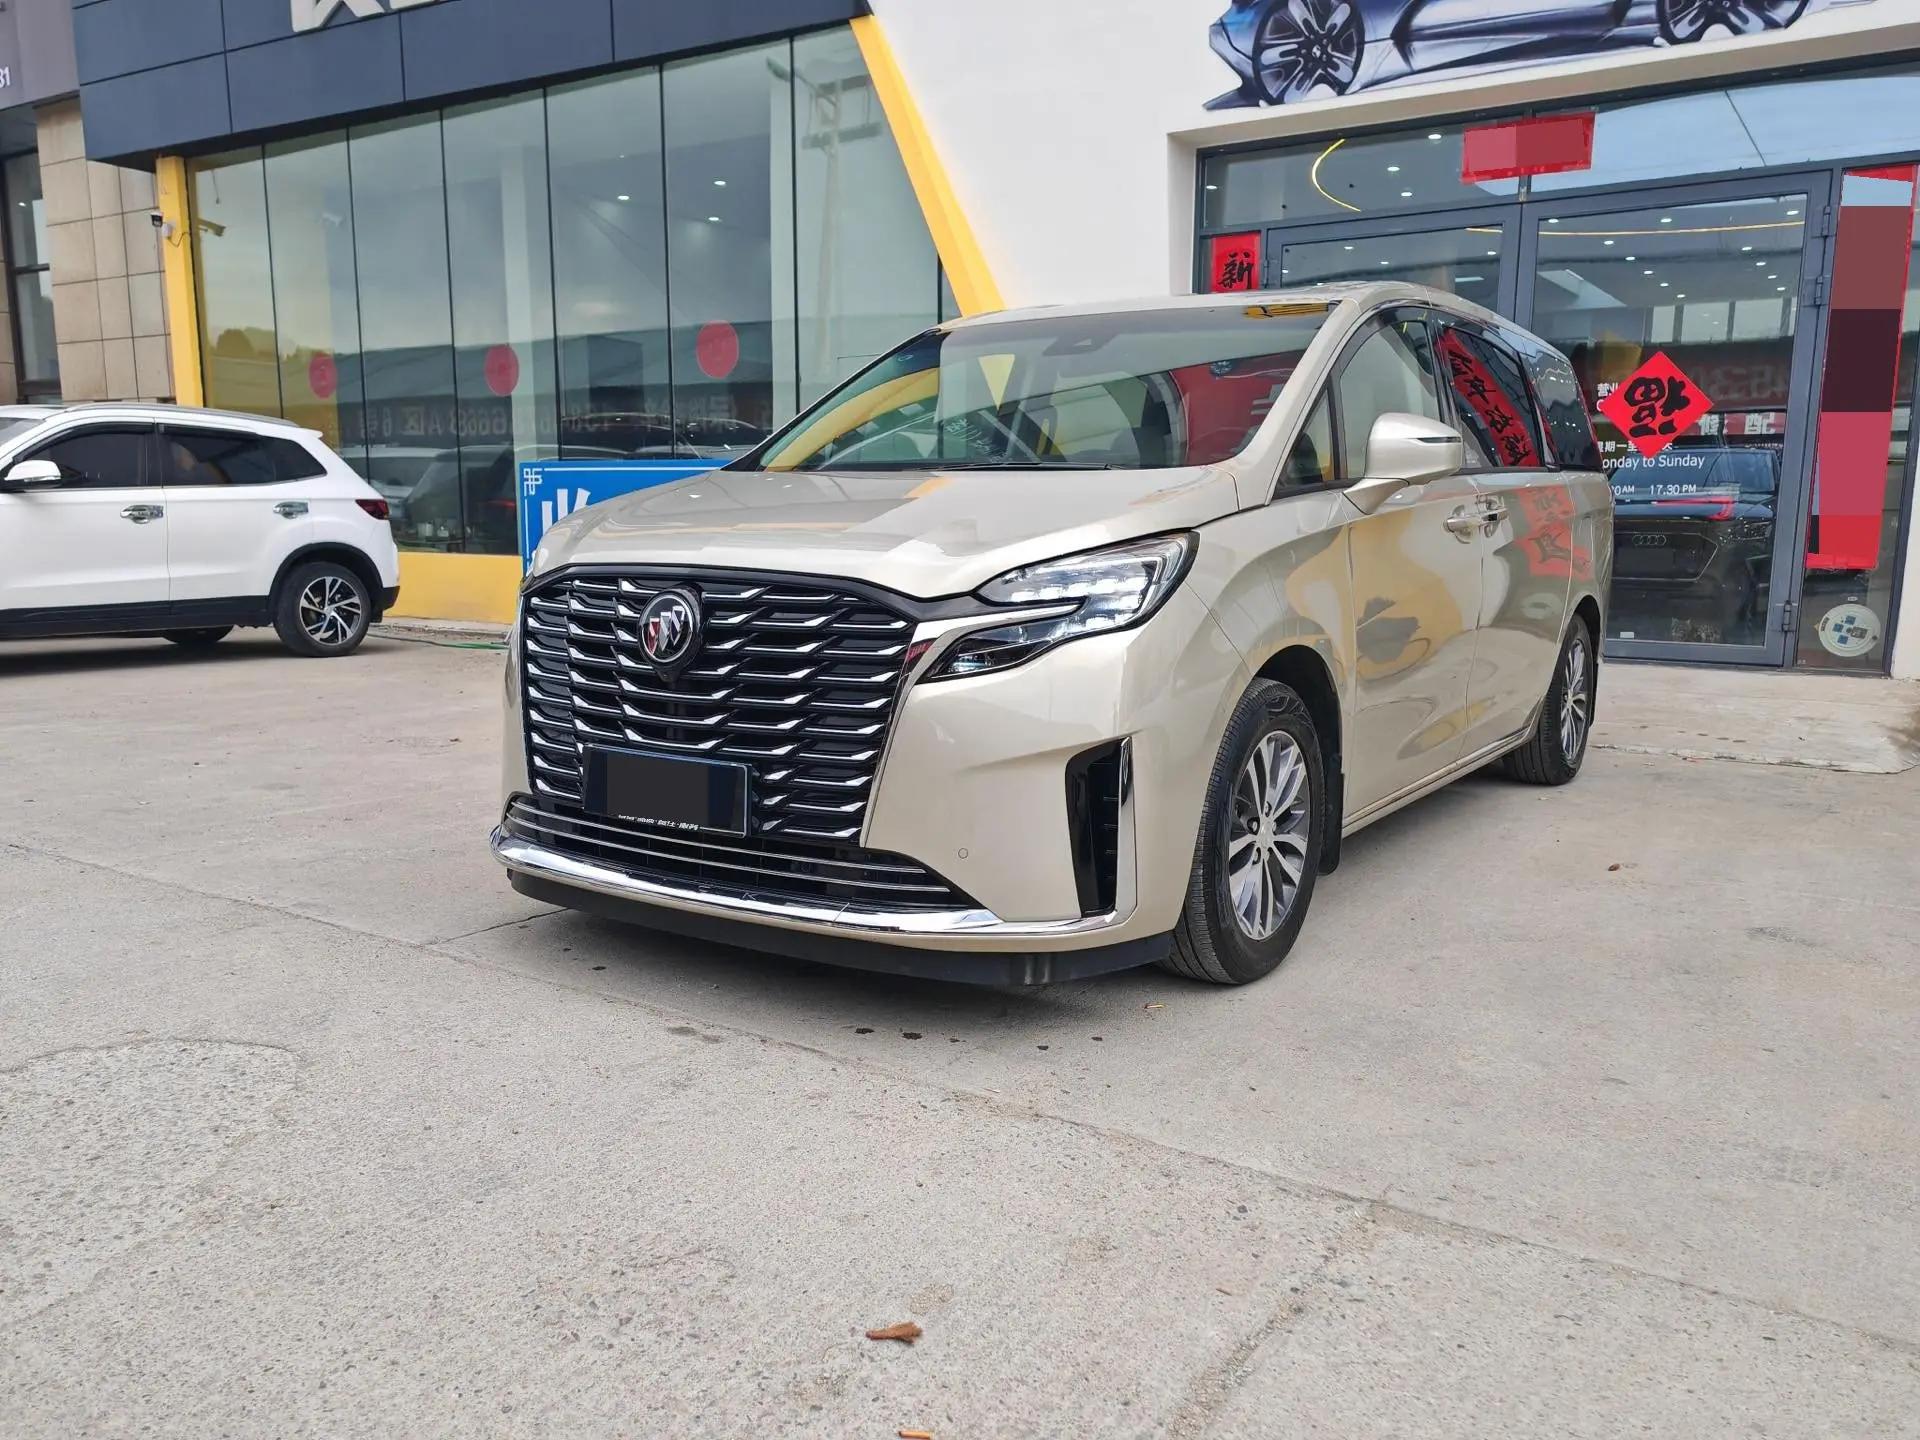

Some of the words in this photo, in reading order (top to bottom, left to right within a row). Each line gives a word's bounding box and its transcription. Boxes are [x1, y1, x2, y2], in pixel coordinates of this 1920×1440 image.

[1602, 456, 1640, 471] onday
[1642, 456, 1656, 468] to
[1658, 454, 1706, 469] Sunday
[1622, 485, 1635, 494] AM
[1650, 484, 1680, 496] 17.30
[1682, 483, 1697, 494] PM
